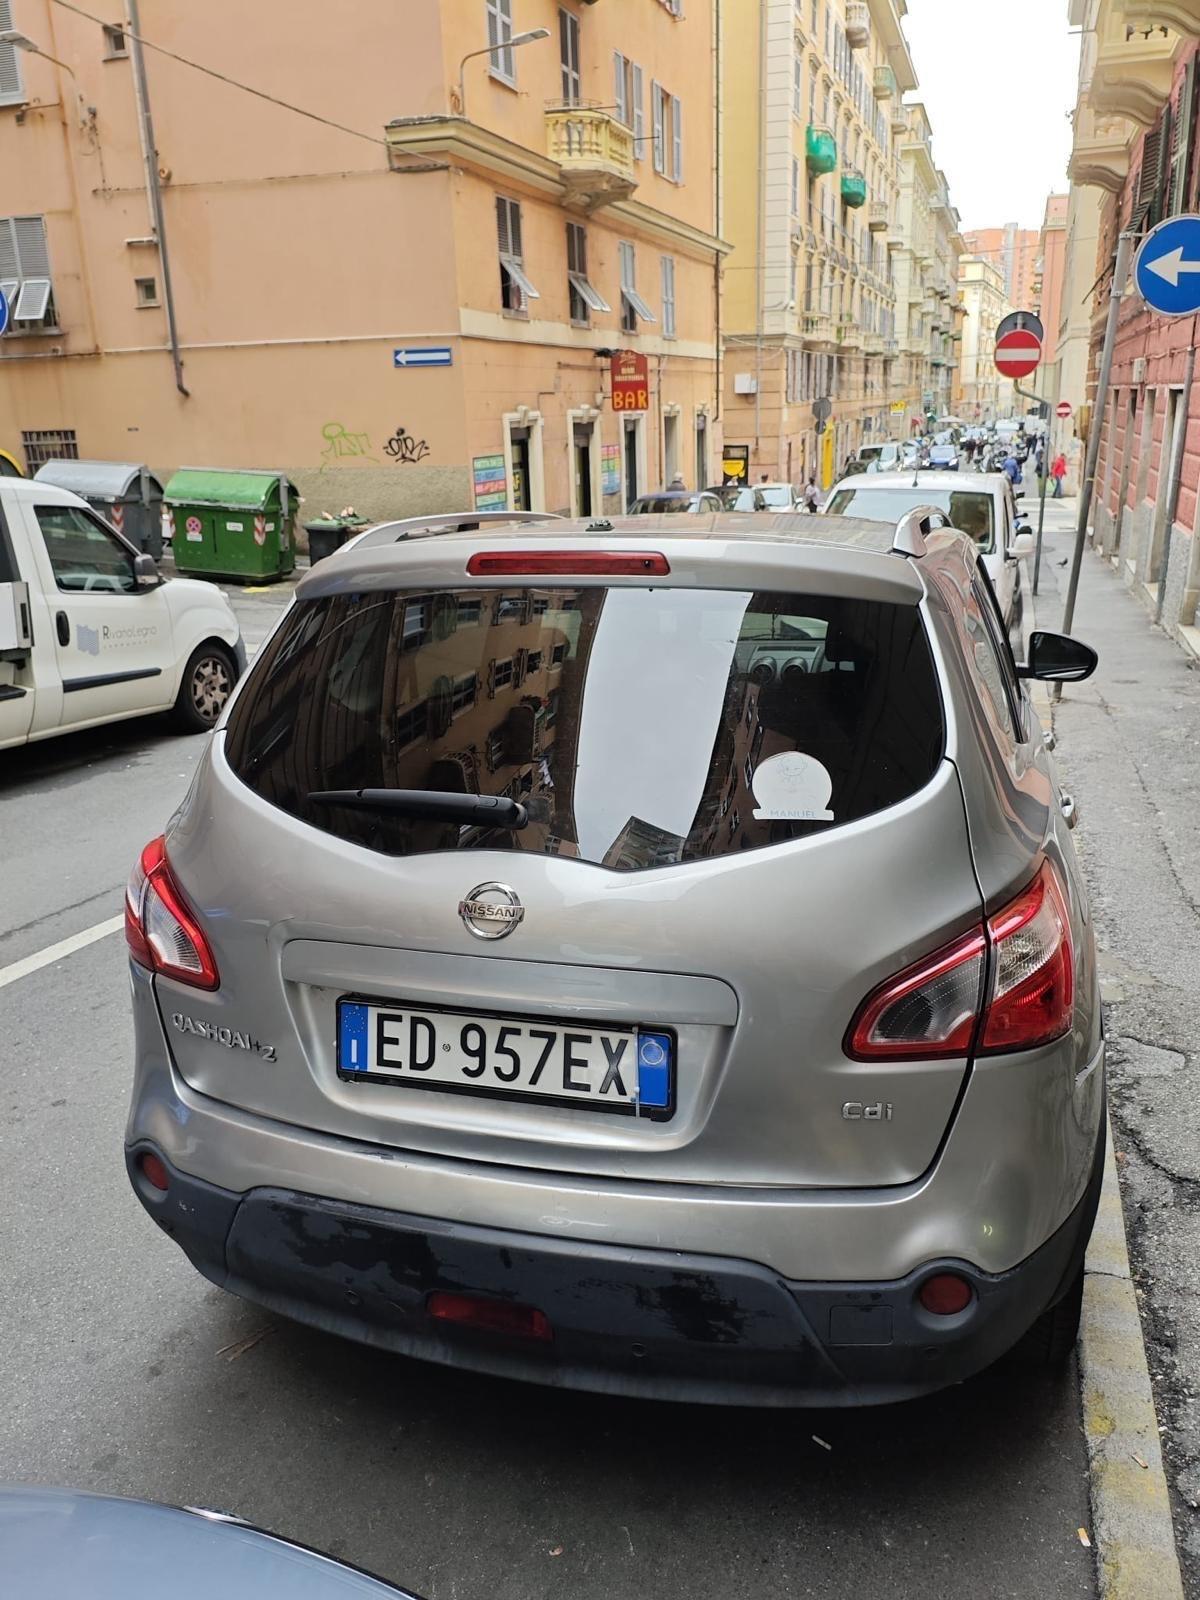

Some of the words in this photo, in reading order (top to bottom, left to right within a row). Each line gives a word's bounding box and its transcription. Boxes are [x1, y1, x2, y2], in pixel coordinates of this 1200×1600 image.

[613, 390, 647, 409] BAR
[769, 809, 817, 819] MANUEL
[464, 903, 516, 918] NISSAN
[376, 1012, 436, 1072] ED
[460, 1023, 629, 1097] 957EX
[842, 1102, 893, 1121] Cdi
